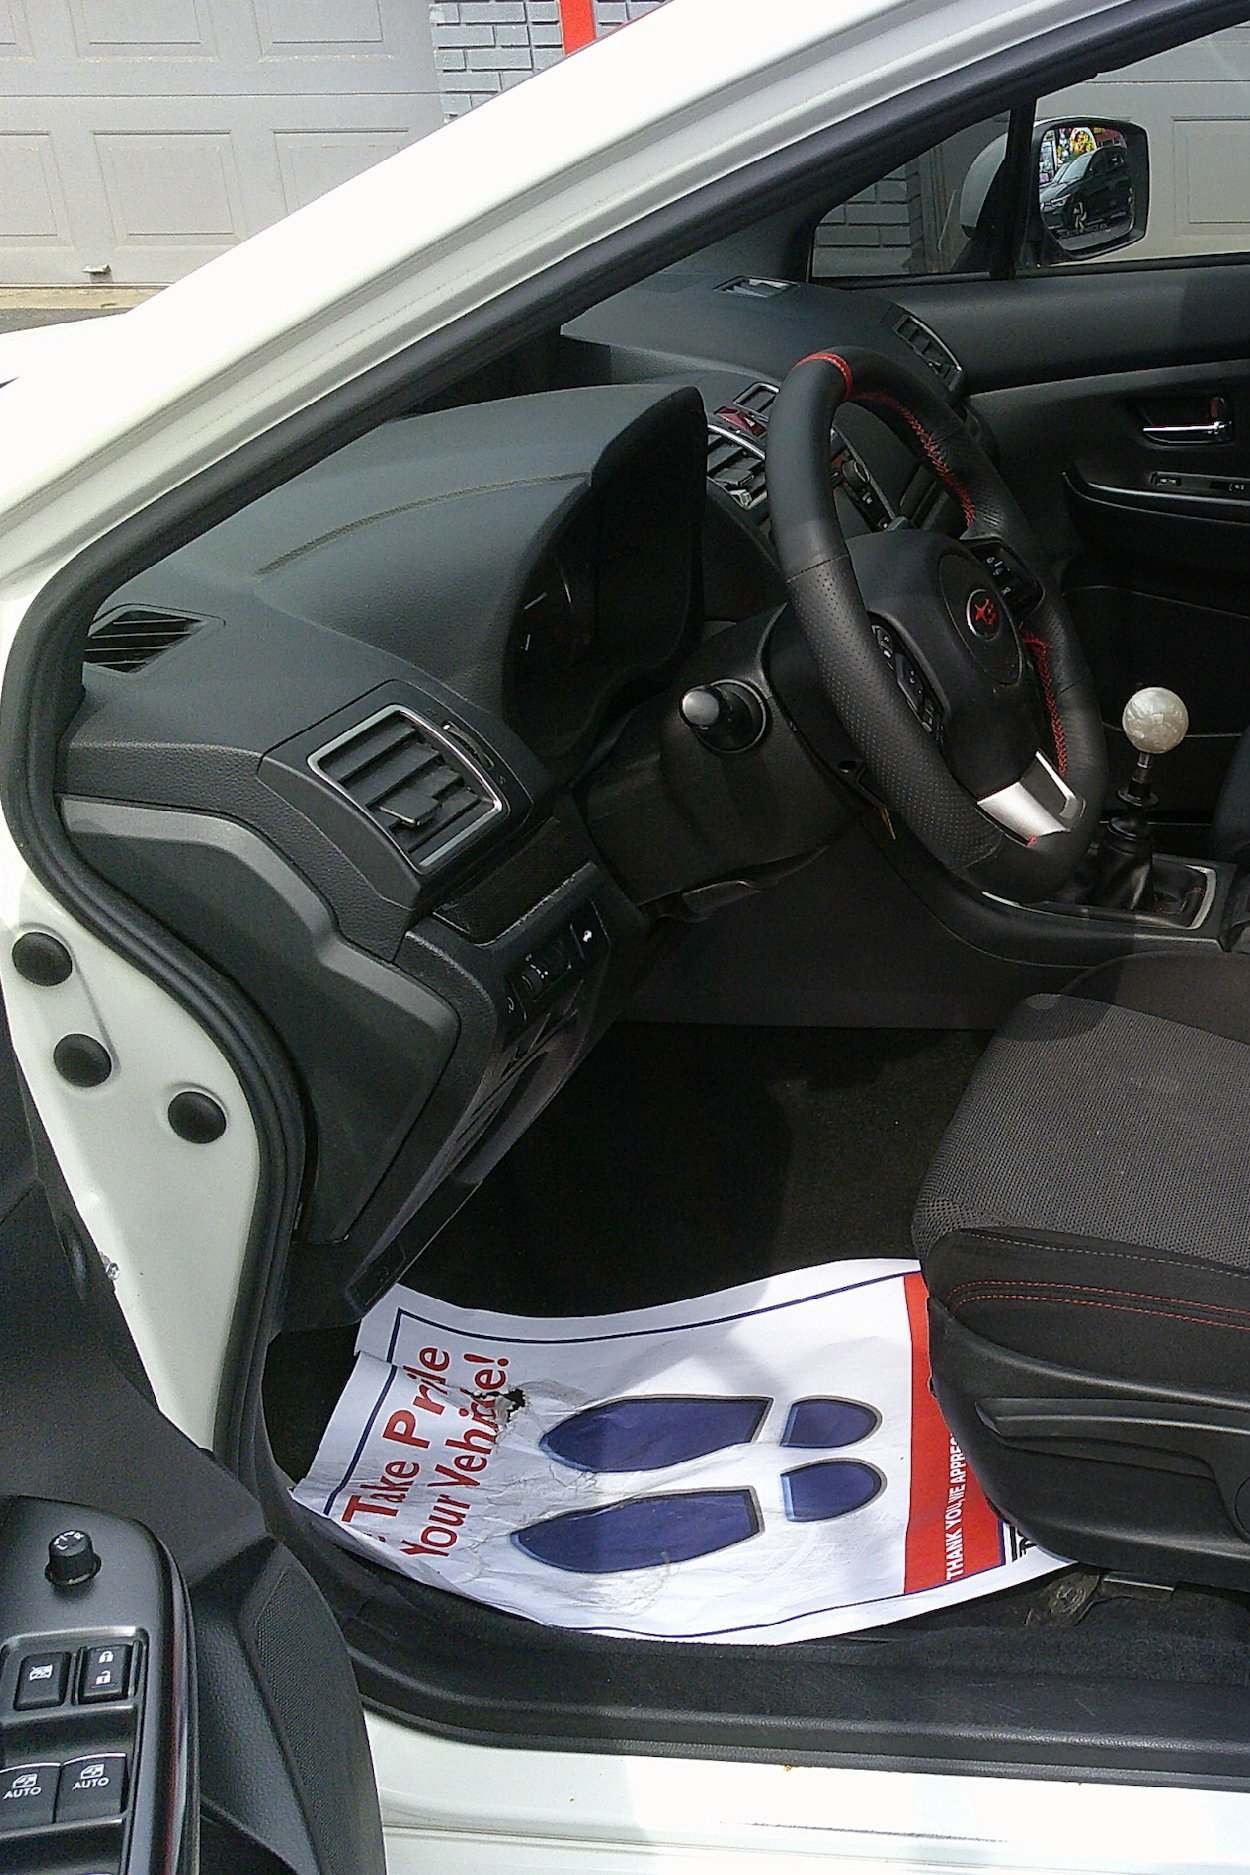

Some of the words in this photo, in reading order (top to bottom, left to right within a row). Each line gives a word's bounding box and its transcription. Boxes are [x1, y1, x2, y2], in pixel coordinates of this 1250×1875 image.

[341, 1460, 420, 1523] Take
[400, 1494, 471, 1557] Your
[945, 1528, 964, 1581] THANK
[3, 1787, 42, 1800] AUTO
[72, 1777, 110, 1791] AUTO
